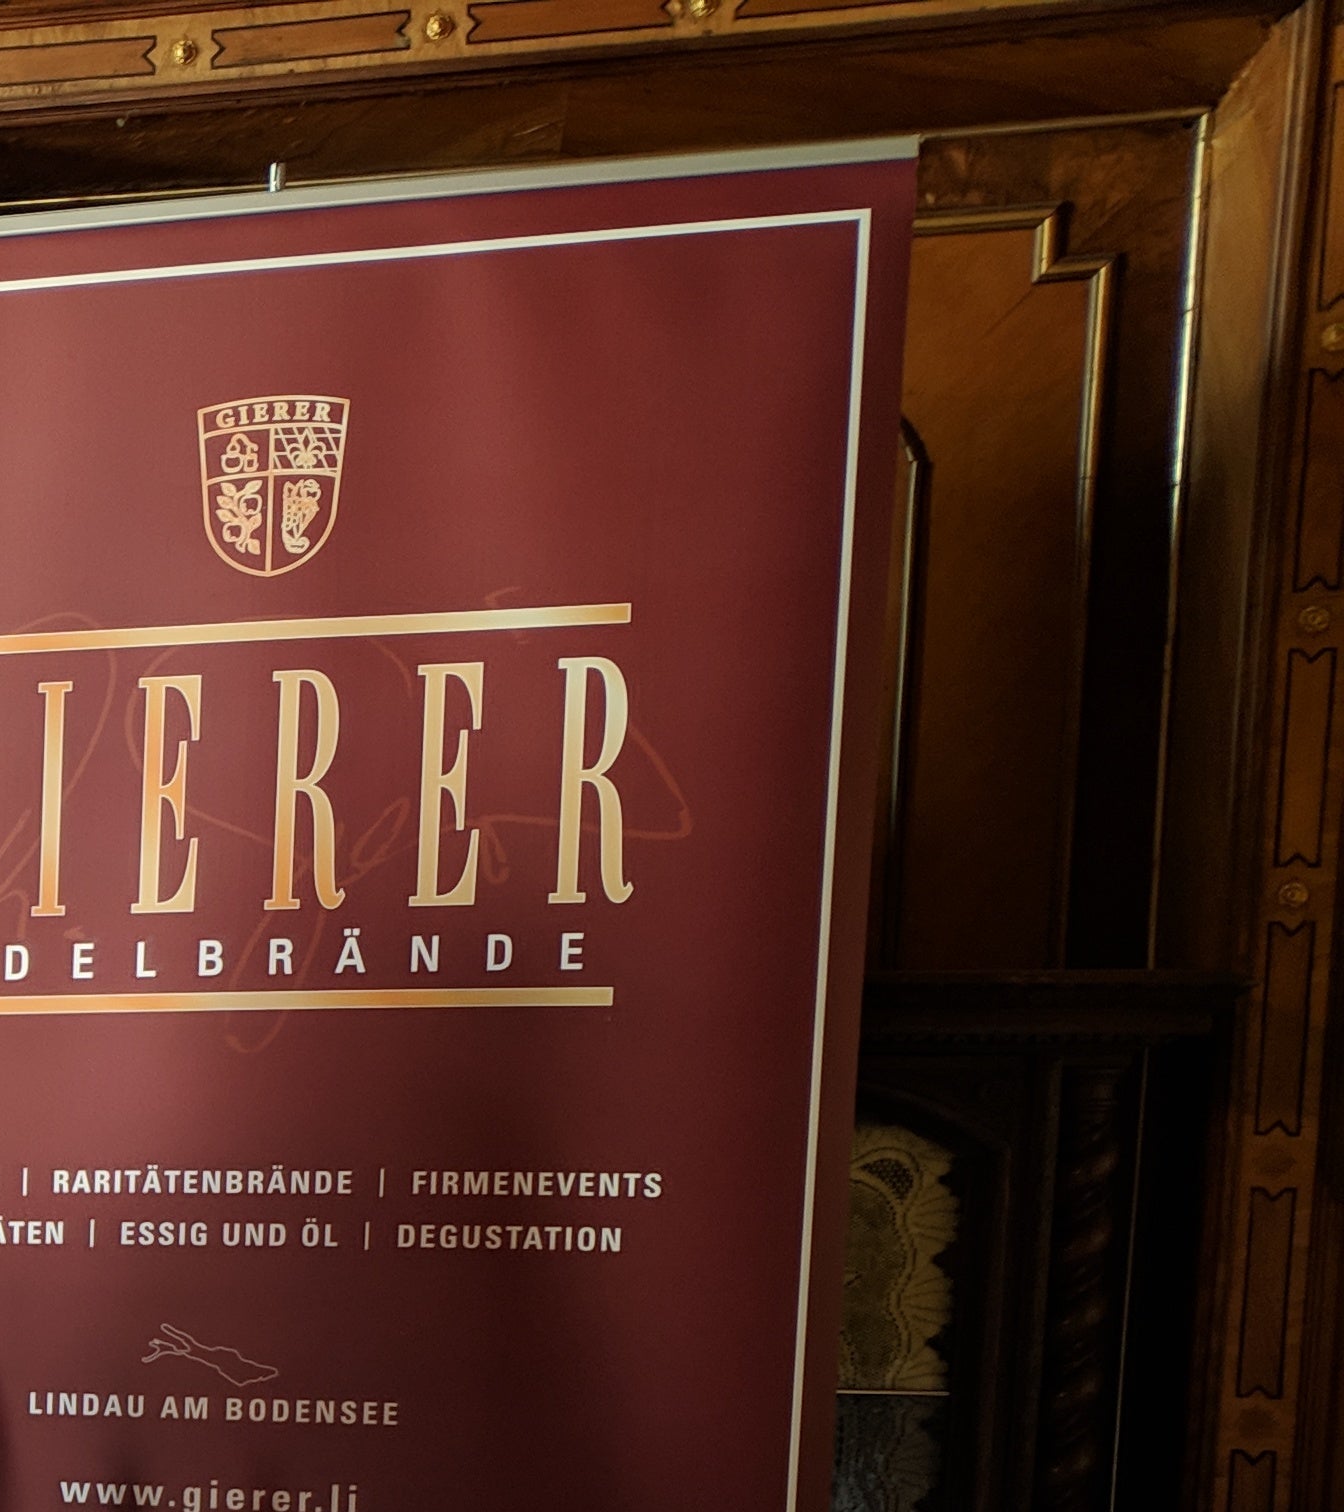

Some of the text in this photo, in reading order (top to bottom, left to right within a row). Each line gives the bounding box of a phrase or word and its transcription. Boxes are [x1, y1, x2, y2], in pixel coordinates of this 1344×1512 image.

[215, 401, 331, 429] GIERER
[53, 1164, 353, 1195] RARITÄTENBRÄNDE
[412, 1170, 663, 1198] FIRMENEVENTS
[120, 1221, 208, 1247] ESSIG
[222, 1222, 287, 1248] UND
[301, 1217, 339, 1248] ÖL
[397, 1224, 623, 1253] DEGUSTATION
[28, 1391, 399, 1426] LINDAU AM BODENSEE
